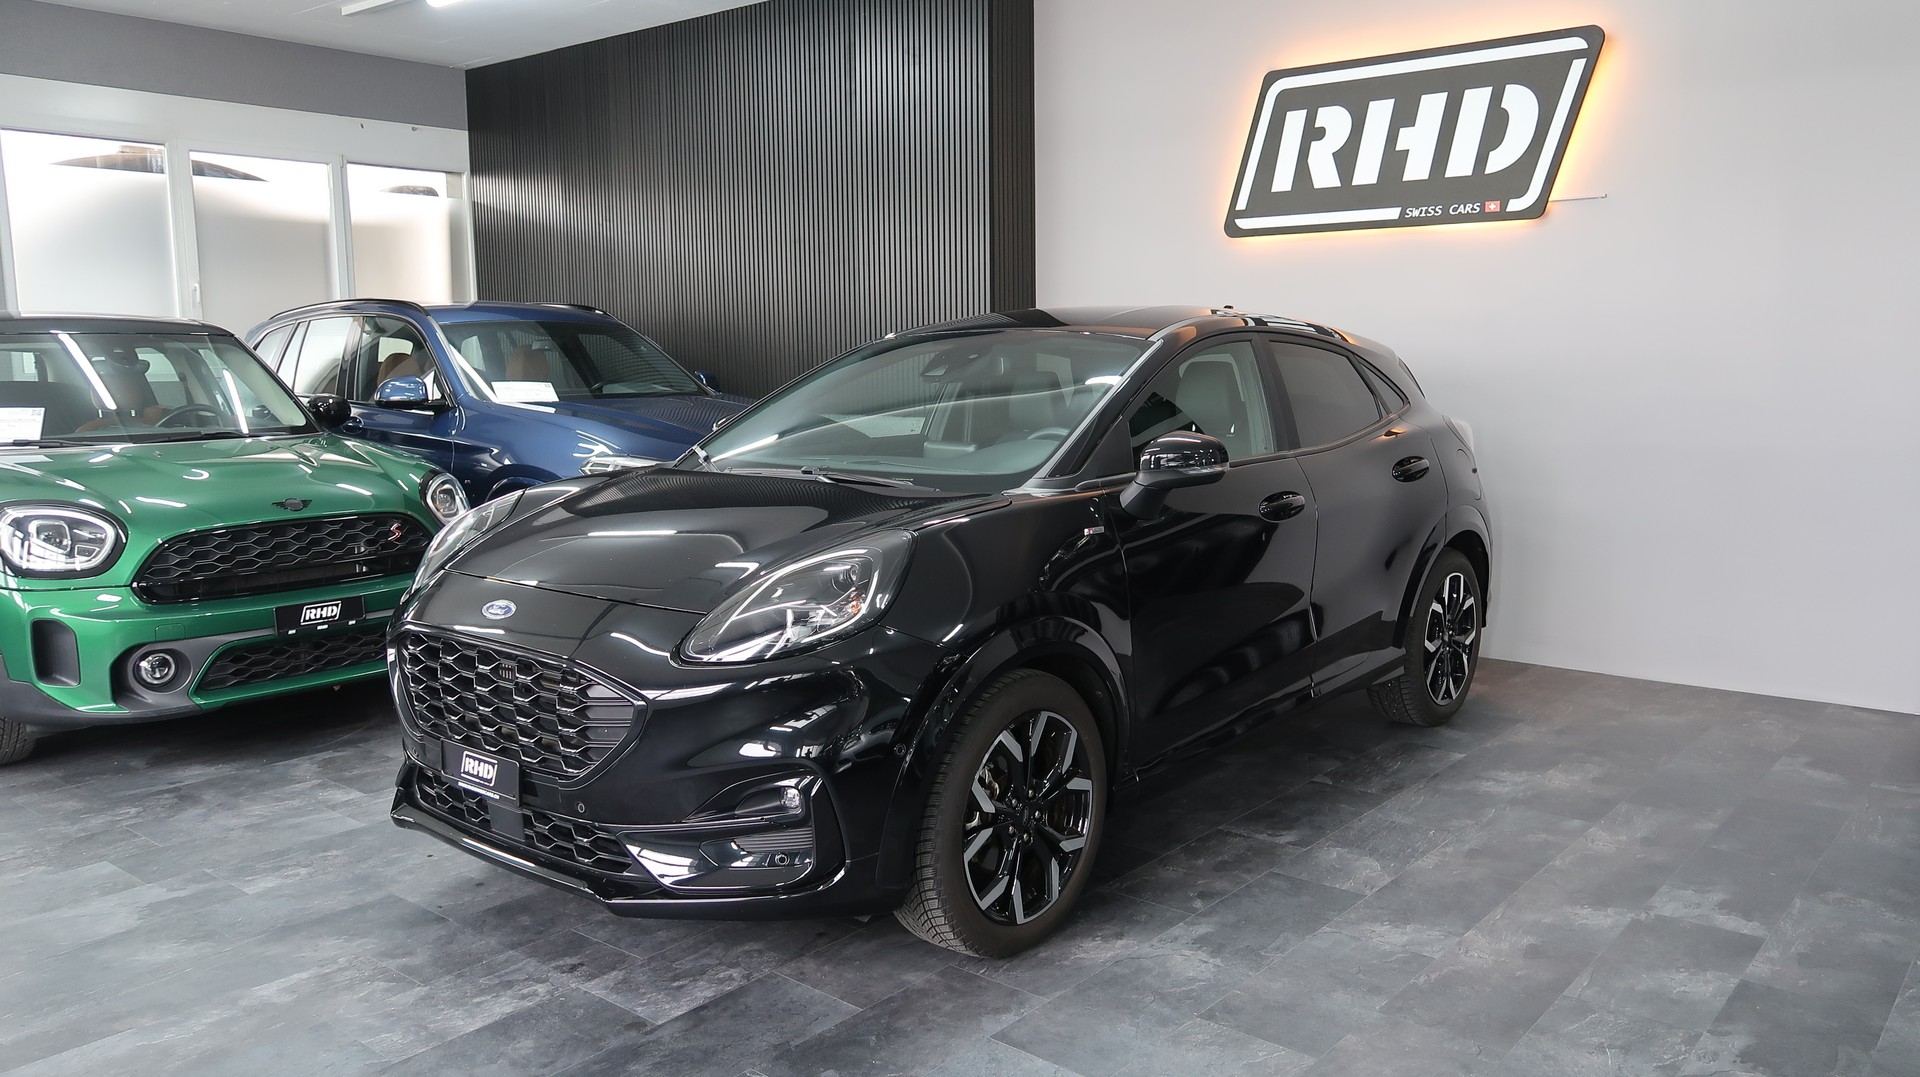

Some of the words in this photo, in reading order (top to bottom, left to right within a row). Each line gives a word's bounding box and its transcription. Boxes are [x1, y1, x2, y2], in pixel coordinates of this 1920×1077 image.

[1270, 83, 1539, 193] RHD
[1404, 206, 1442, 218] SWISS
[1449, 203, 1481, 215] CARS
[305, 605, 338, 620] RHD
[464, 757, 494, 779] RHD
